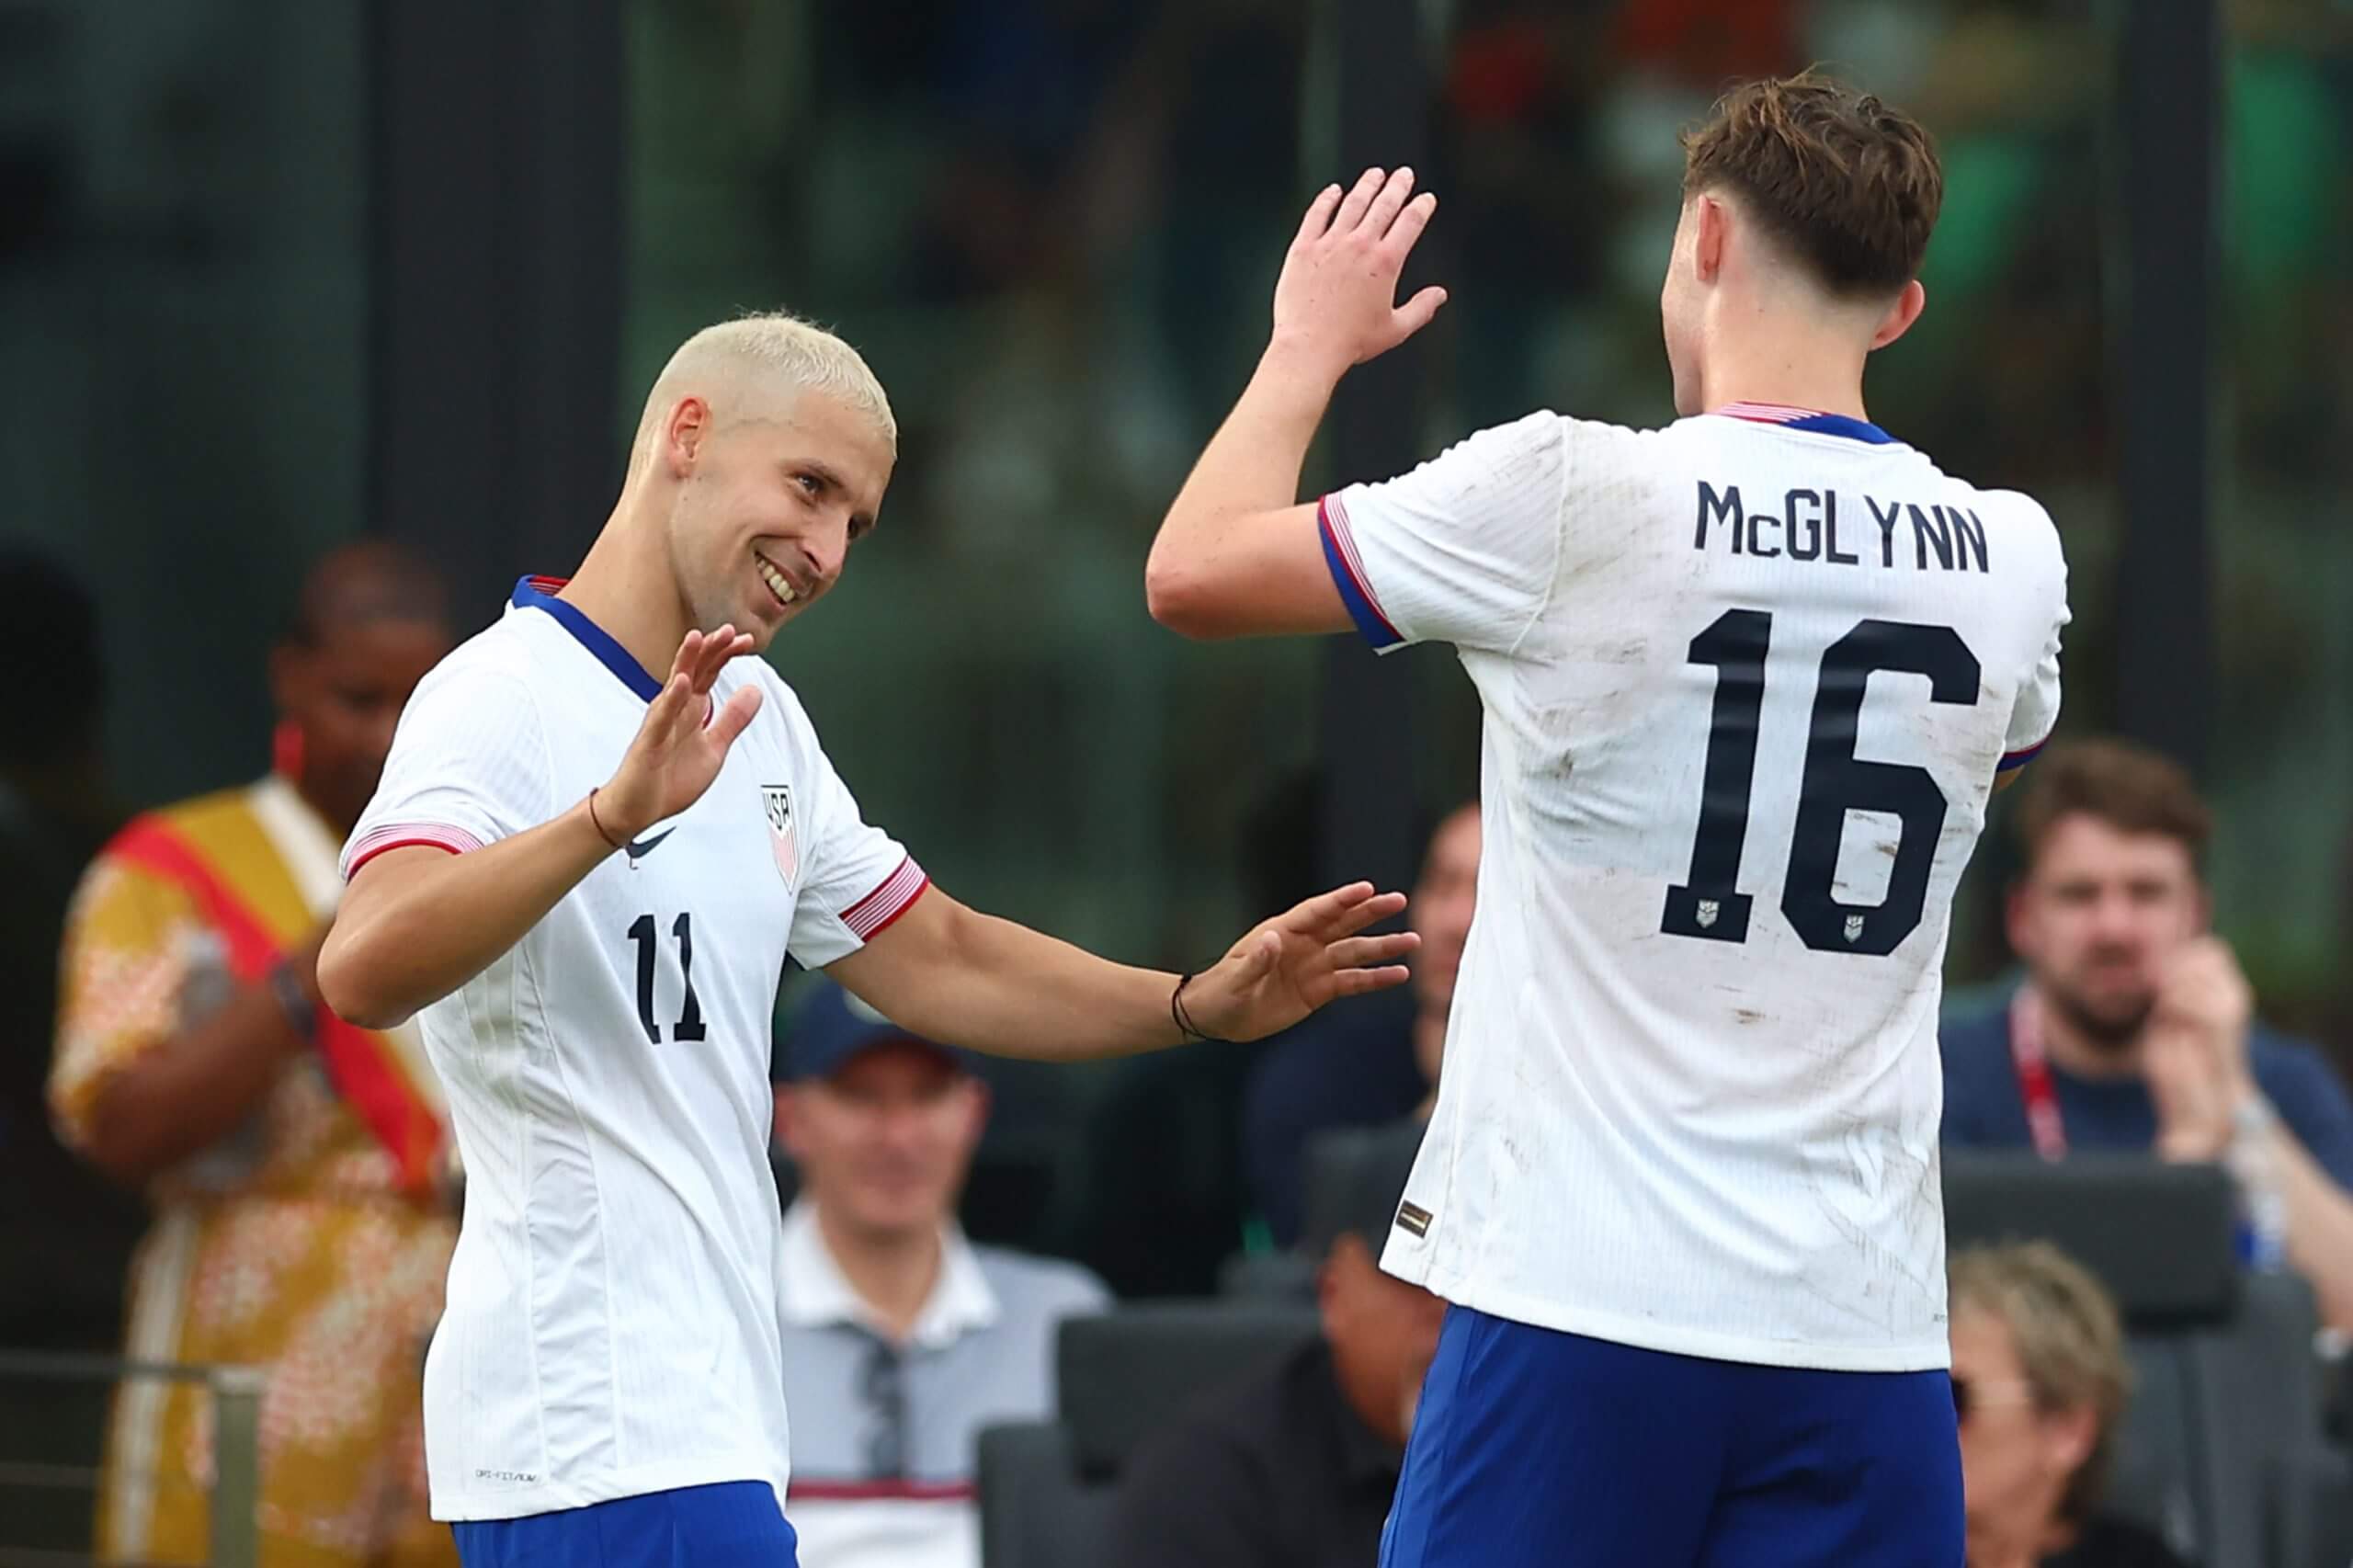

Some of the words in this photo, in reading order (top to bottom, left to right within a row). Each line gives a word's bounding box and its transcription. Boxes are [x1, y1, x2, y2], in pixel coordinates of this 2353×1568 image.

[1694, 481, 1990, 574] McGLYNN
[1660, 608, 1982, 957] 16
[627, 912, 707, 1045] 11
